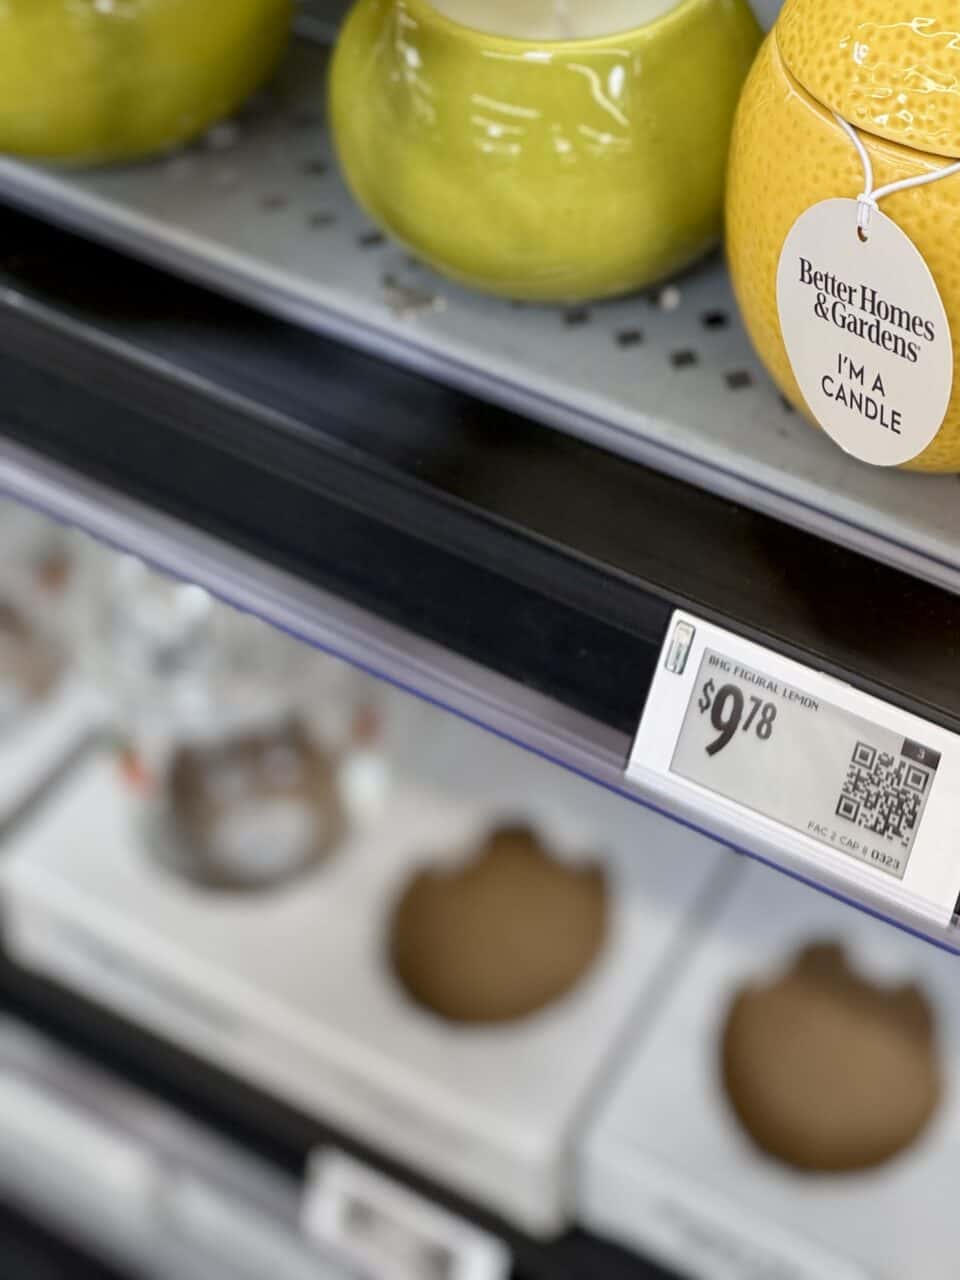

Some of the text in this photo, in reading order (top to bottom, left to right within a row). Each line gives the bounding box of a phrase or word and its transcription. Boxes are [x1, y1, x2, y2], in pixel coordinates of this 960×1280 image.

[798, 257, 935, 342] Better Homes
[837, 353, 887, 397] I'M A
[821, 375, 902, 435] CANDLE
[708, 654, 820, 712] BHG FIGURAL LEMON
[839, 835, 860, 850] CAP
